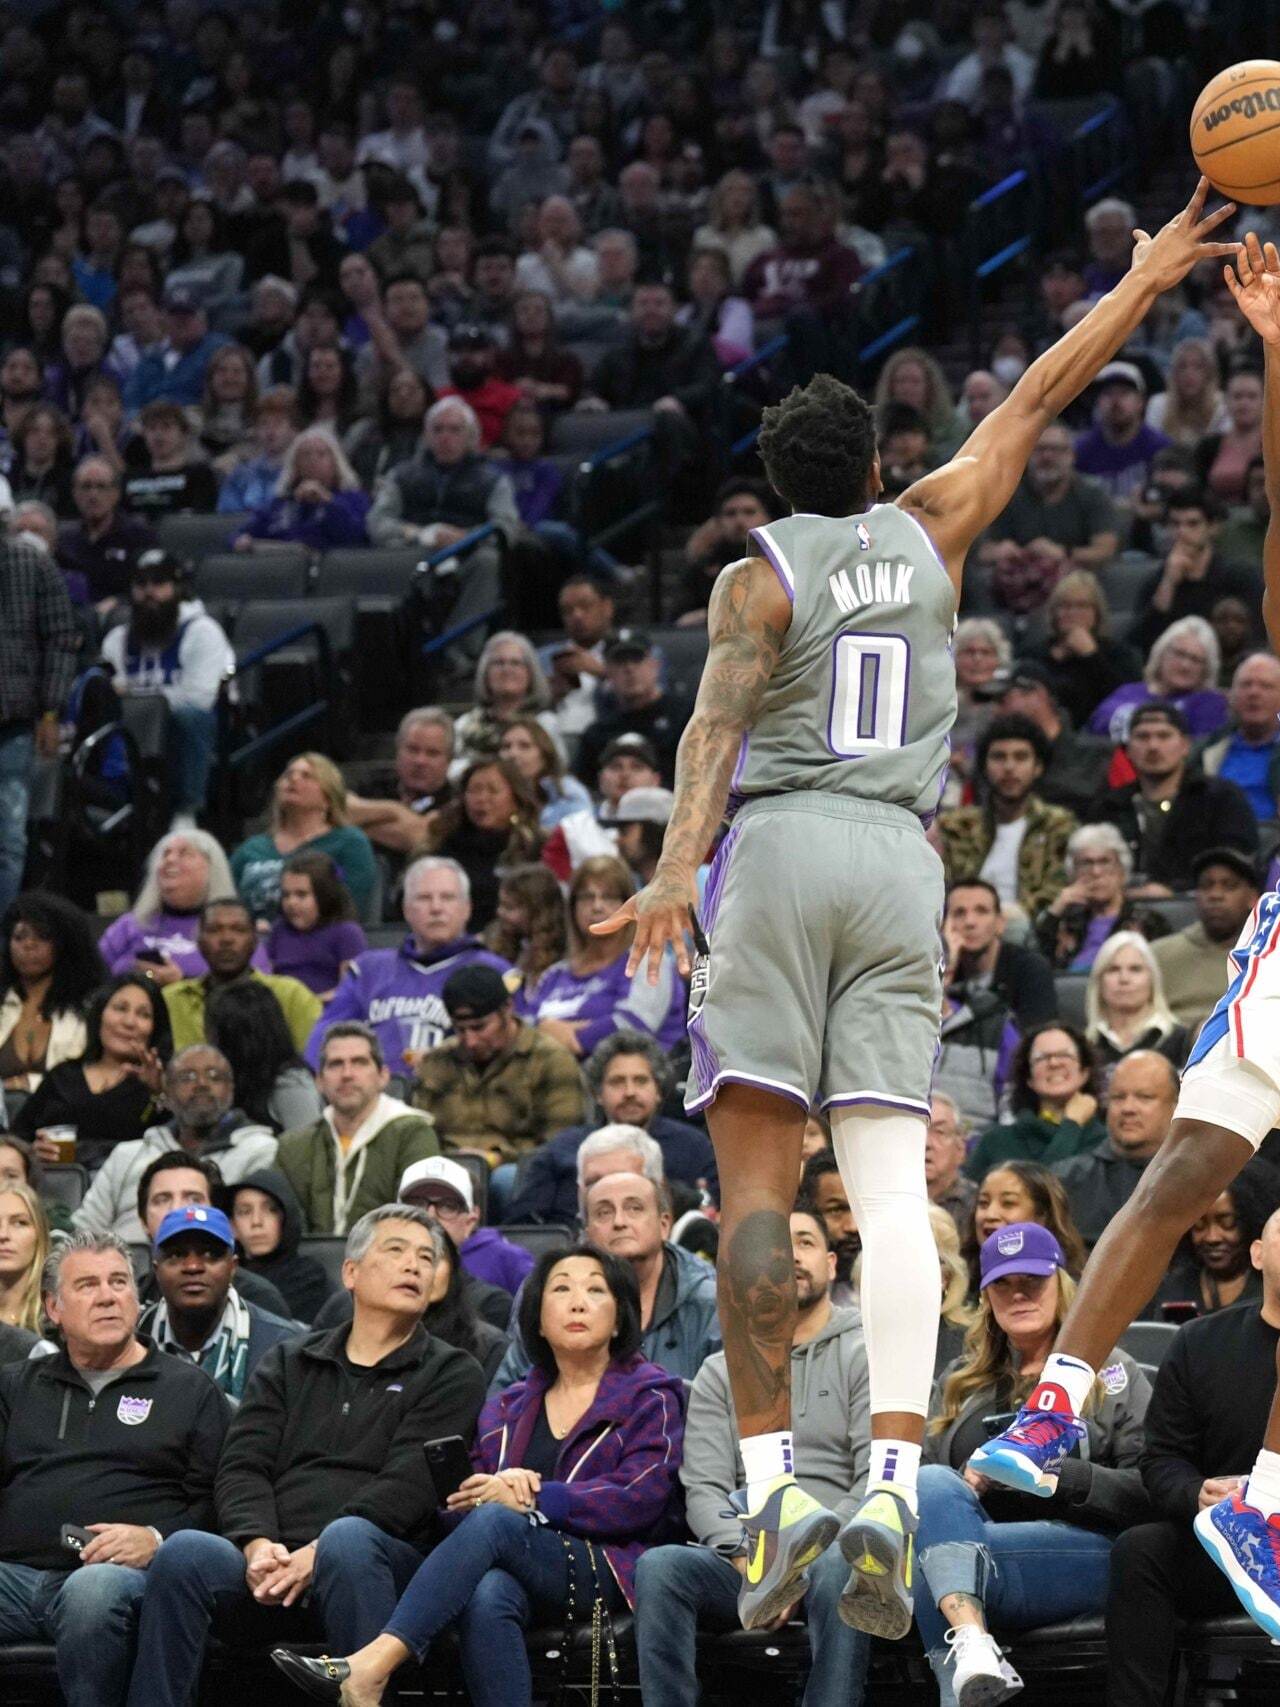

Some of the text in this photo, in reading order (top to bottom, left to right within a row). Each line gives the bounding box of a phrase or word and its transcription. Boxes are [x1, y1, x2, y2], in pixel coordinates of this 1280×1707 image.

[829, 562, 915, 613] MONK
[828, 630, 911, 761] 0
[1038, 1390, 1056, 1411] 0
